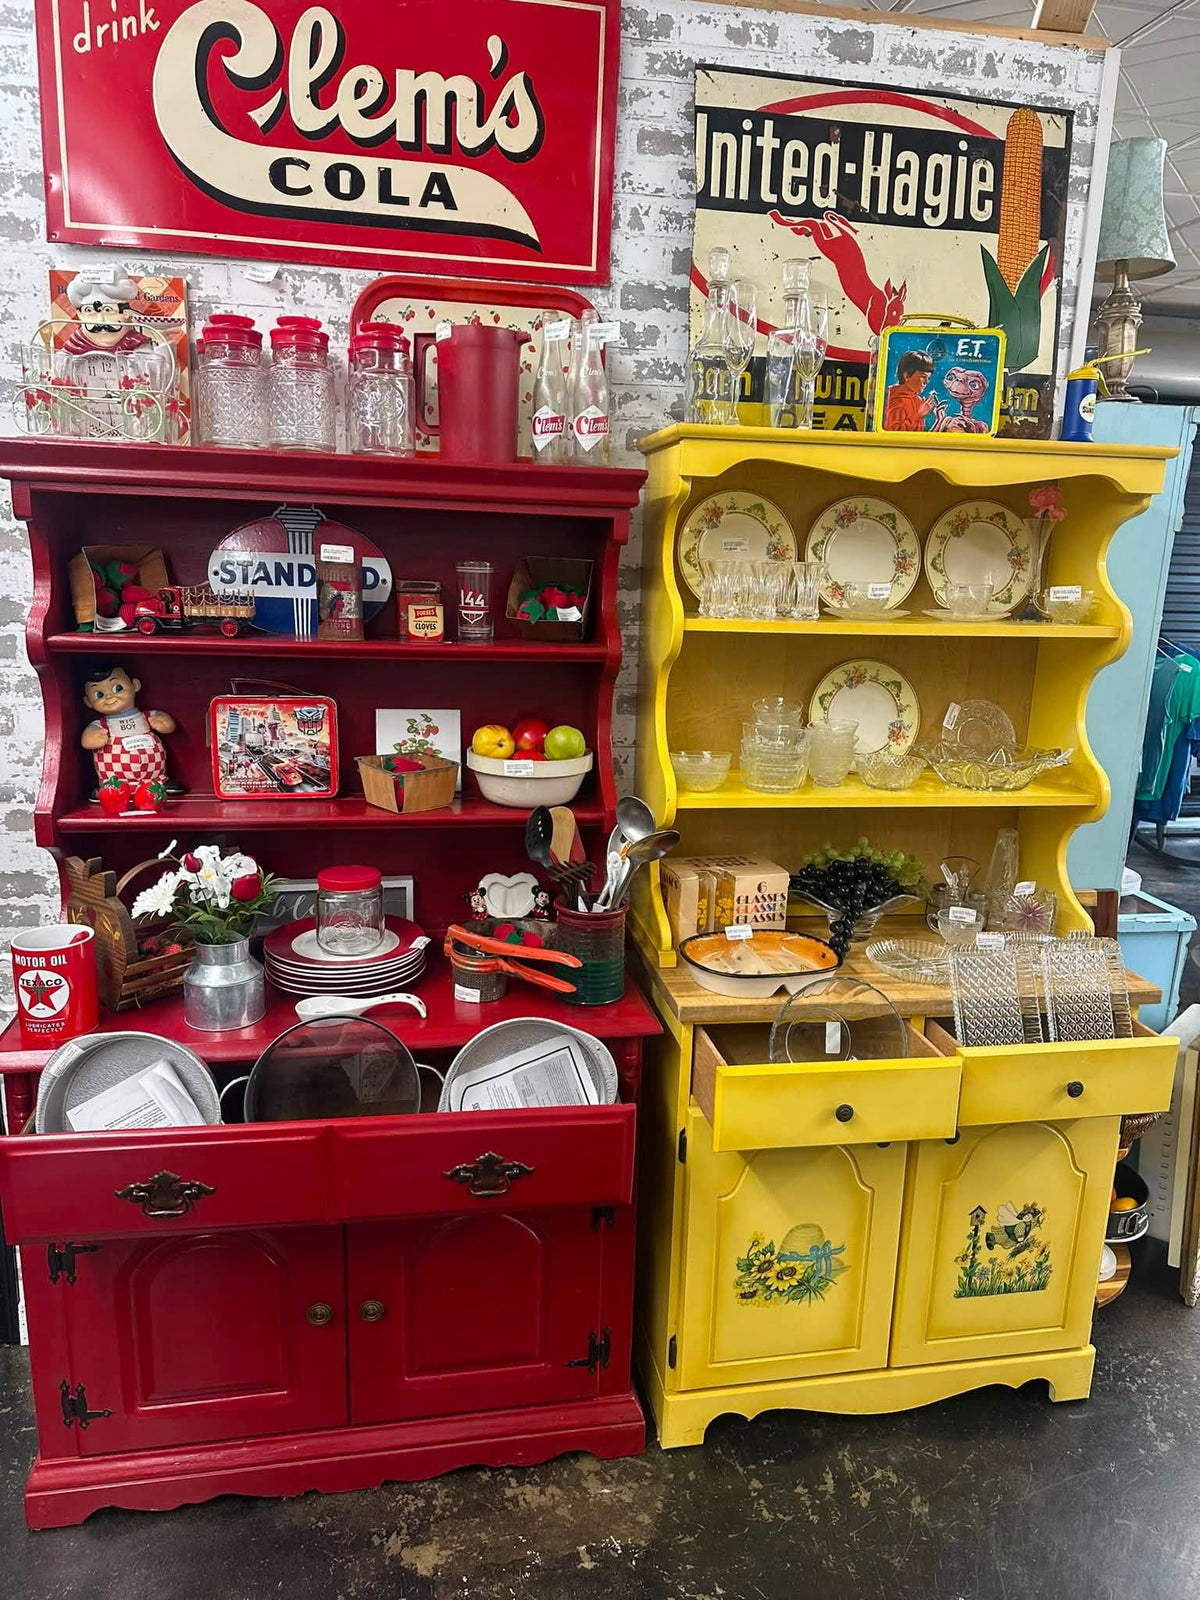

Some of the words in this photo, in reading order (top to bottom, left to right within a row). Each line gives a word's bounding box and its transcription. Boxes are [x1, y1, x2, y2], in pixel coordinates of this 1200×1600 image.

[73, 0, 160, 53] drink
[152, 0, 544, 253] Clem's
[268, 156, 458, 211] COLA
[143, 291, 180, 304] Gardens
[956, 338, 986, 358] E.T.
[88, 365, 97, 377] 11
[102, 361, 113, 373] 12
[533, 416, 563, 436] Clem's
[576, 416, 608, 436] Clem's
[220, 559, 380, 590] STANDD
[415, 622, 437, 630] CLOVES
[757, 881, 768, 893] 6
[736, 892, 787, 905] GLASSES
[736, 902, 786, 915] GLASSES
[735, 912, 785, 925] GLASSES
[14, 953, 46, 967] MOTOR
[50, 953, 68, 966] OIL
[20, 978, 63, 987] TEXACO
[30, 987, 48, 1003] T
[25, 1021, 66, 1030] LUBRICATES
